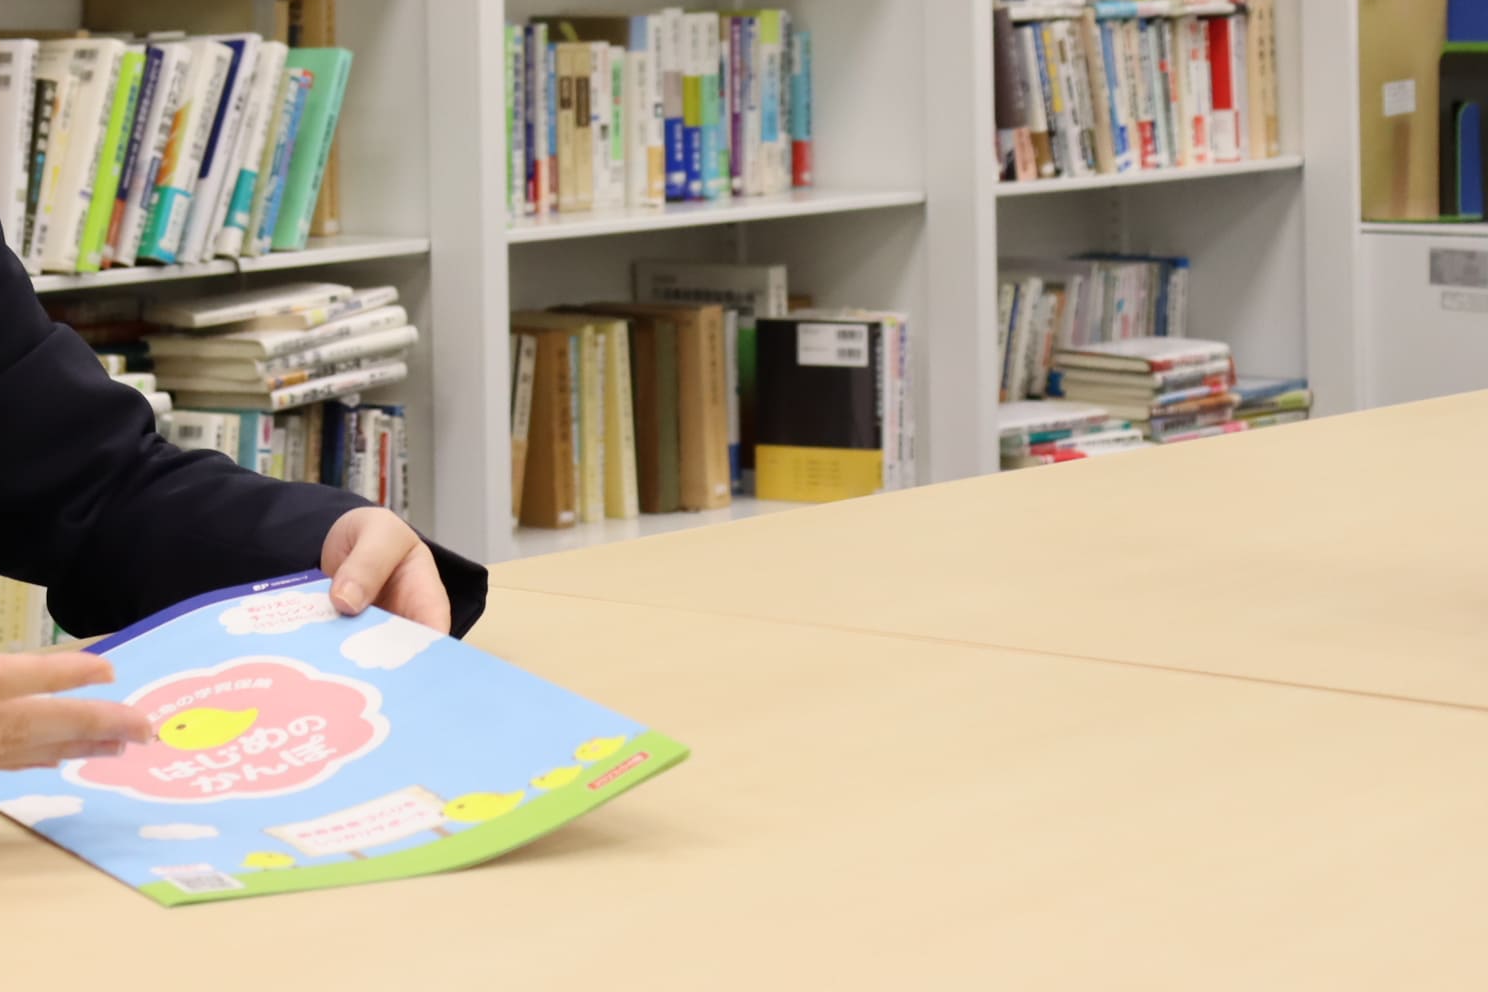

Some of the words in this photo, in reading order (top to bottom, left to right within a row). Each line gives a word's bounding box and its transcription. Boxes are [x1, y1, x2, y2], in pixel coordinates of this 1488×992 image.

[149, 715, 327, 782] はじめの
[191, 734, 337, 794] かんぽ
